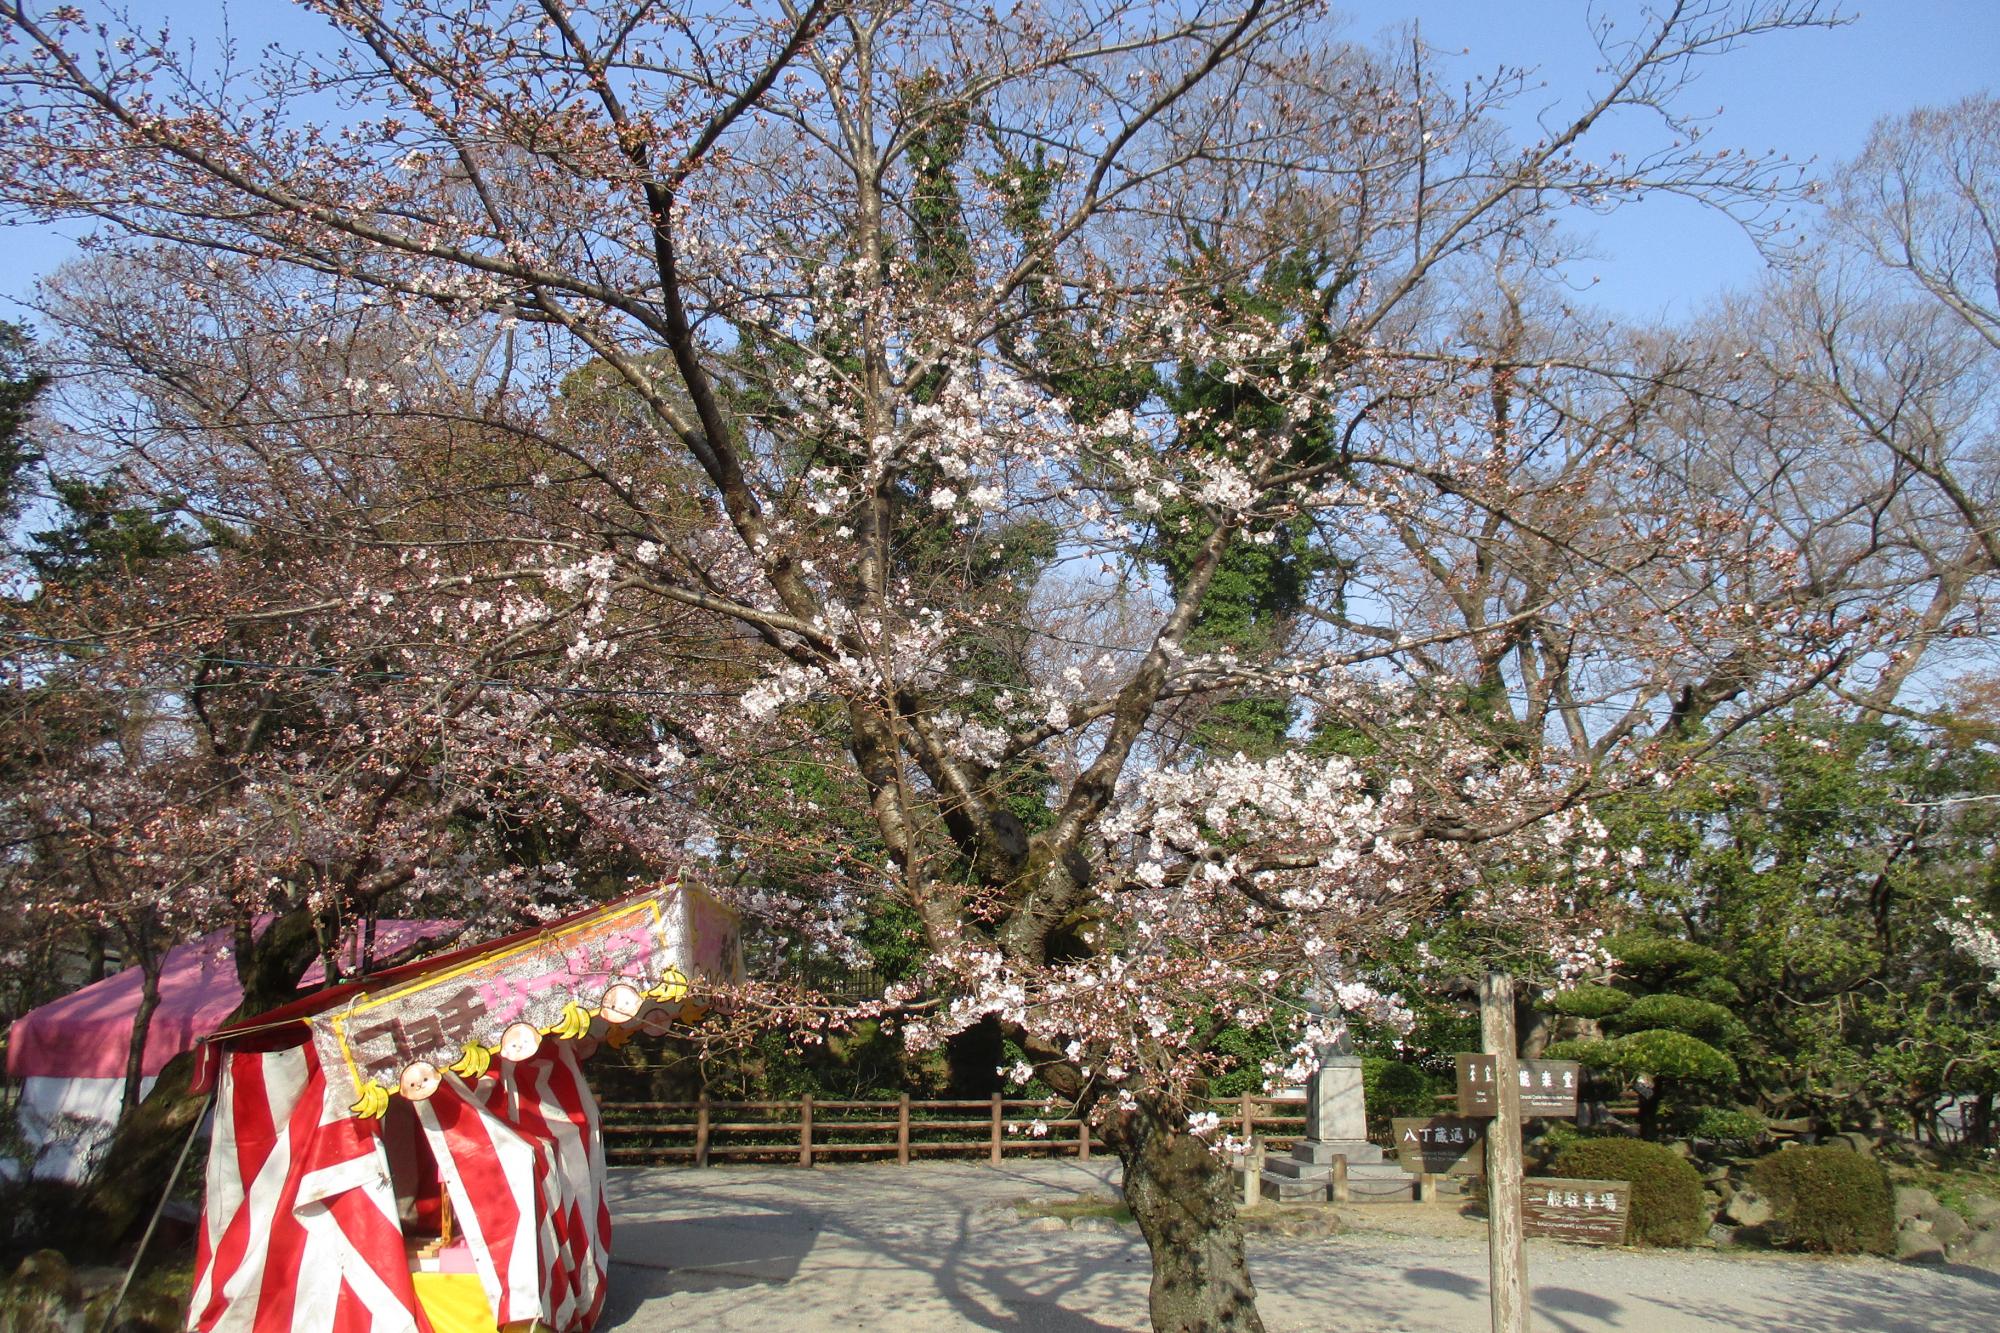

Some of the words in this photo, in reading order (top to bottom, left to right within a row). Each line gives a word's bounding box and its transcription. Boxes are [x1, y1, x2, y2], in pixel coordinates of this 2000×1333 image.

[1403, 1127, 1477, 1144] 八丁蔵通り
[1528, 1190, 1618, 1212] 一般駐車場
